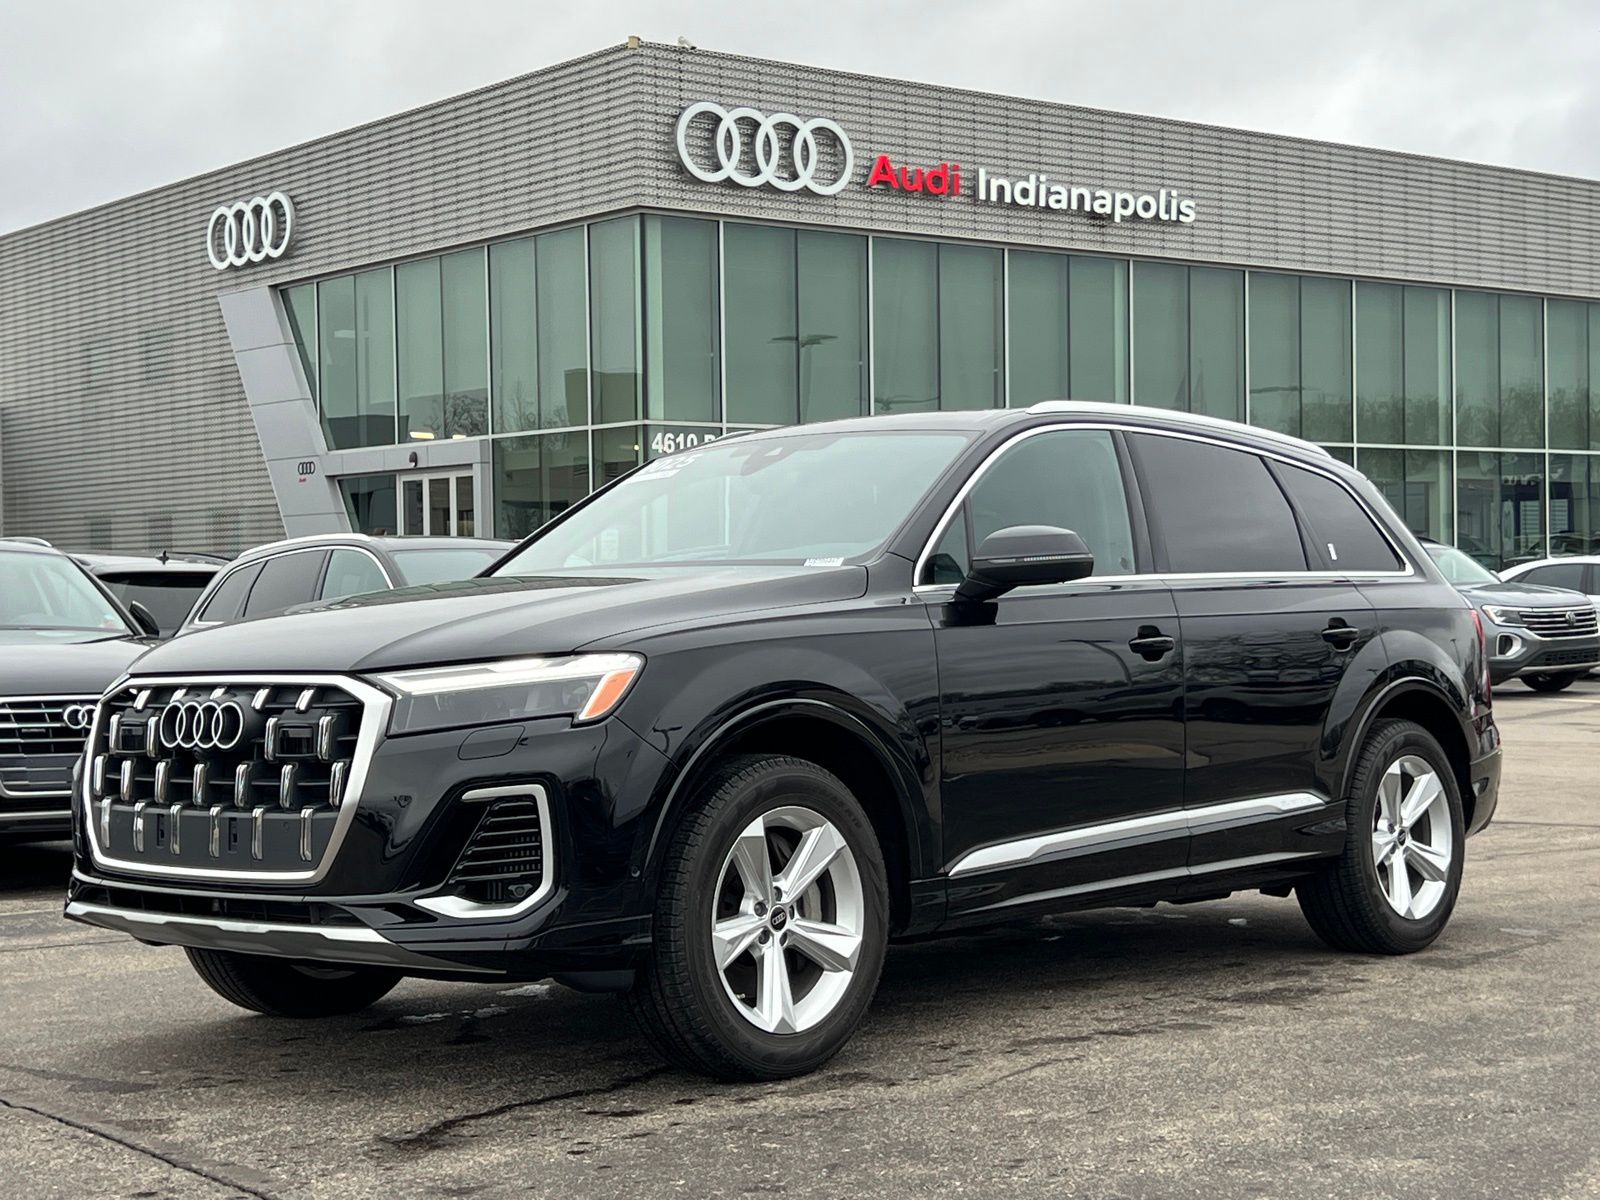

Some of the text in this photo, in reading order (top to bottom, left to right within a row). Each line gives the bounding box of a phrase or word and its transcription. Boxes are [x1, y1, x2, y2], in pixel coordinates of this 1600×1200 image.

[867, 154, 1196, 223] Audi Indianapolis
[651, 432, 698, 454] 4610
